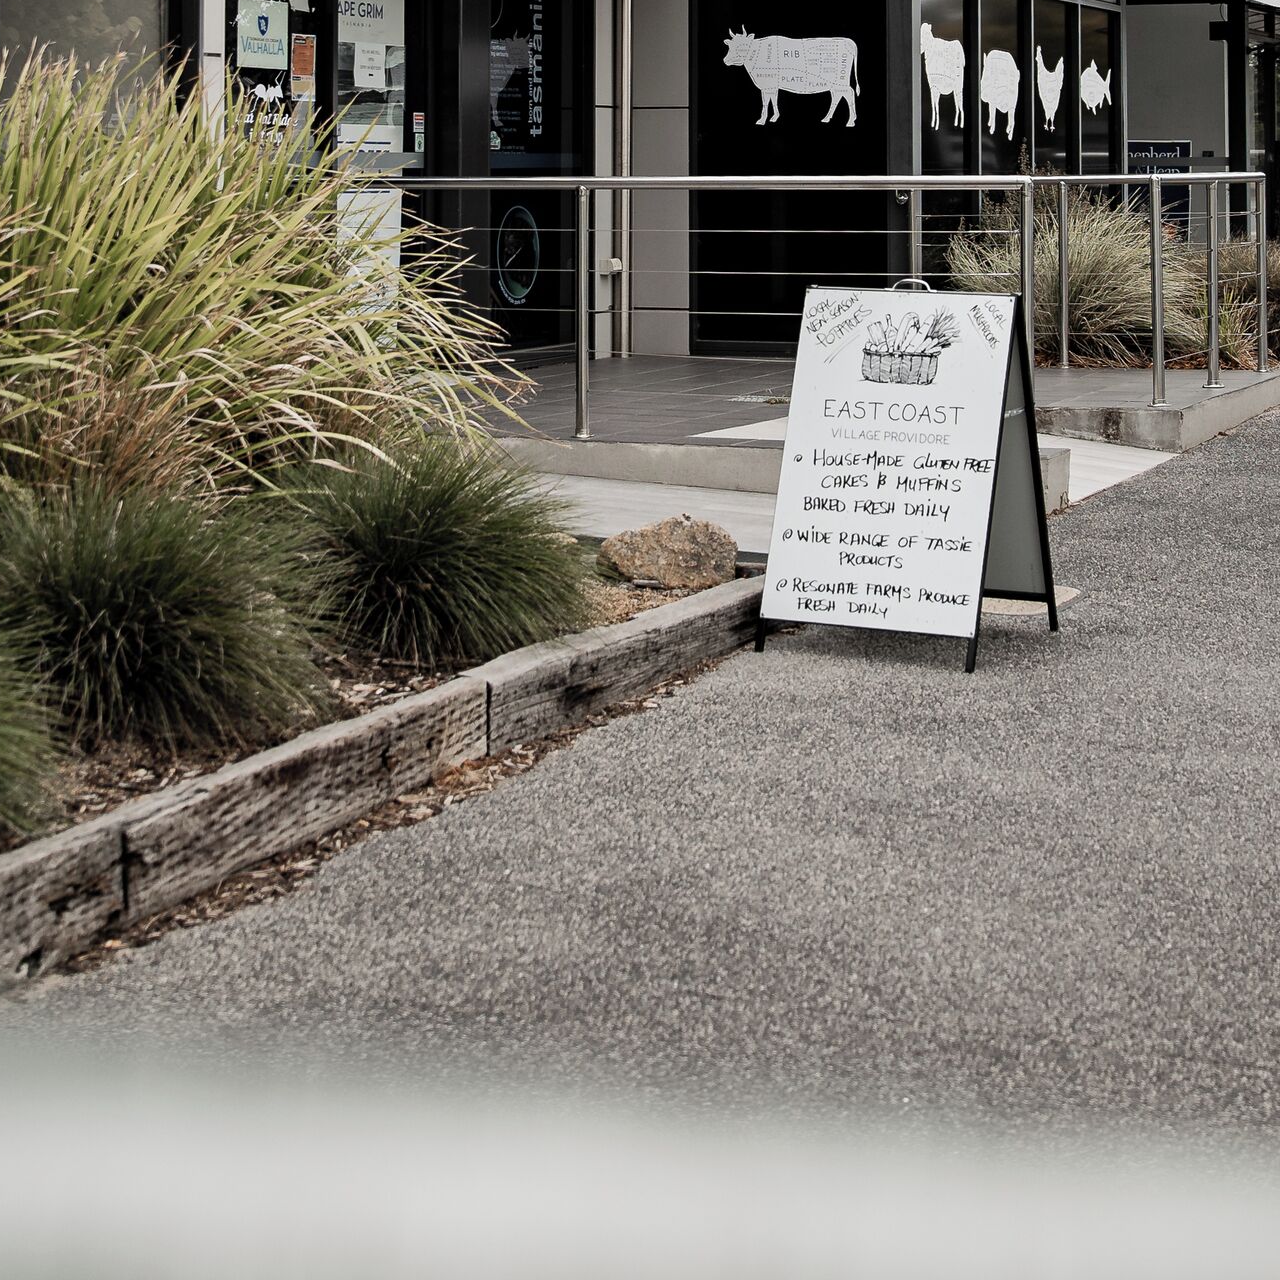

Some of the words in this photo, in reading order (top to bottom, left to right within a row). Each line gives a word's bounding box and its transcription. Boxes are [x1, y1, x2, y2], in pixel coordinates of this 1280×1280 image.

[358, 3, 384, 19] GRIM
[240, 35, 284, 56] VALHALLA
[783, 49, 801, 59] RIB
[805, 298, 837, 320] LOCAL
[984, 299, 1007, 330] LOCAL
[823, 398, 884, 421] EAST
[887, 403, 966, 425] COAST
[831, 427, 880, 441] VILLAGE
[883, 431, 951, 446] PROVIDORE
[813, 448, 906, 470] HOUSE-MADE
[963, 457, 995, 473] FREE
[820, 474, 869, 490] CAKES
[803, 495, 846, 512] BAKED
[854, 500, 895, 516] FRESH
[839, 531, 890, 548] RANGE
[897, 535, 919, 549] OF
[839, 551, 904, 569] PRODUCTS
[797, 596, 836, 612] FRESH
[866, 583, 911, 603] FARMS
[918, 588, 971, 607] PRODUCE
